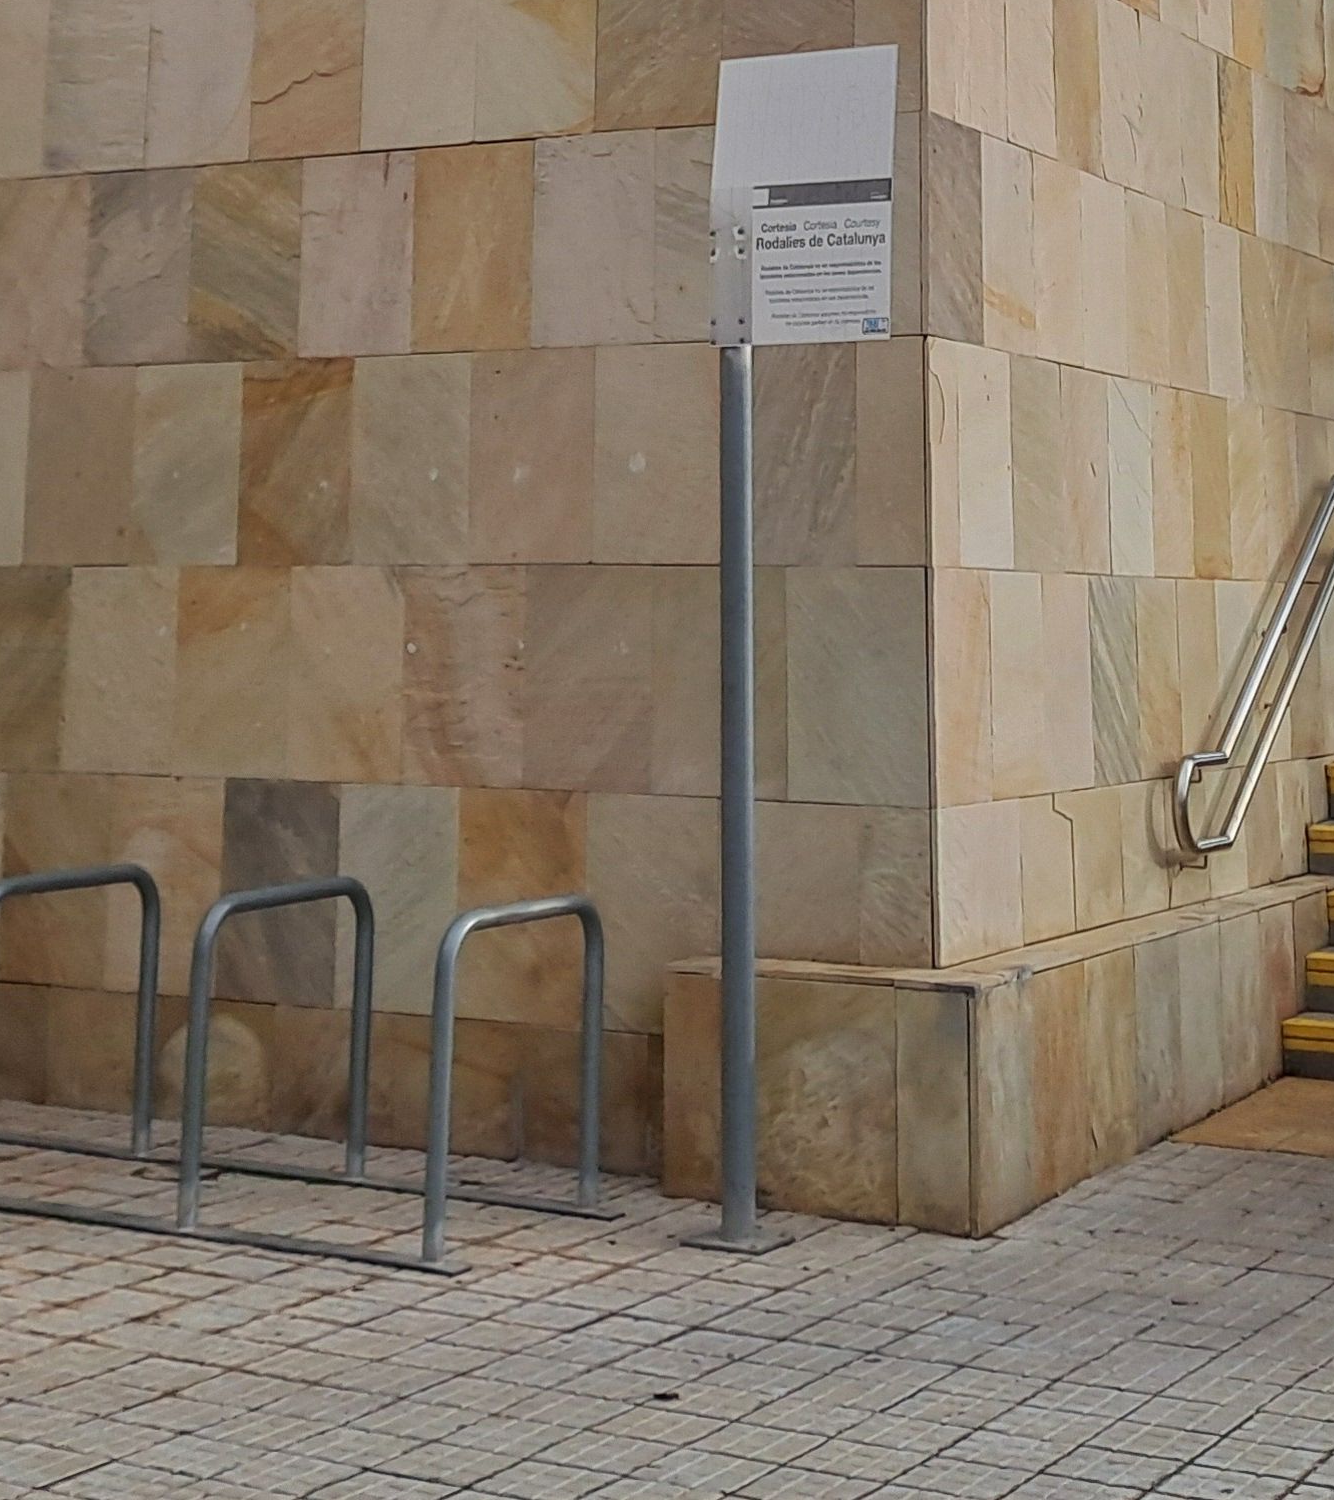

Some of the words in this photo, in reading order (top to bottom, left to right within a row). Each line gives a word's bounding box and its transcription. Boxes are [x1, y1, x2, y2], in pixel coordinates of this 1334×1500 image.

[756, 236, 806, 251] Rodalies
[809, 234, 824, 247] de
[827, 232, 886, 247] Catalunya
